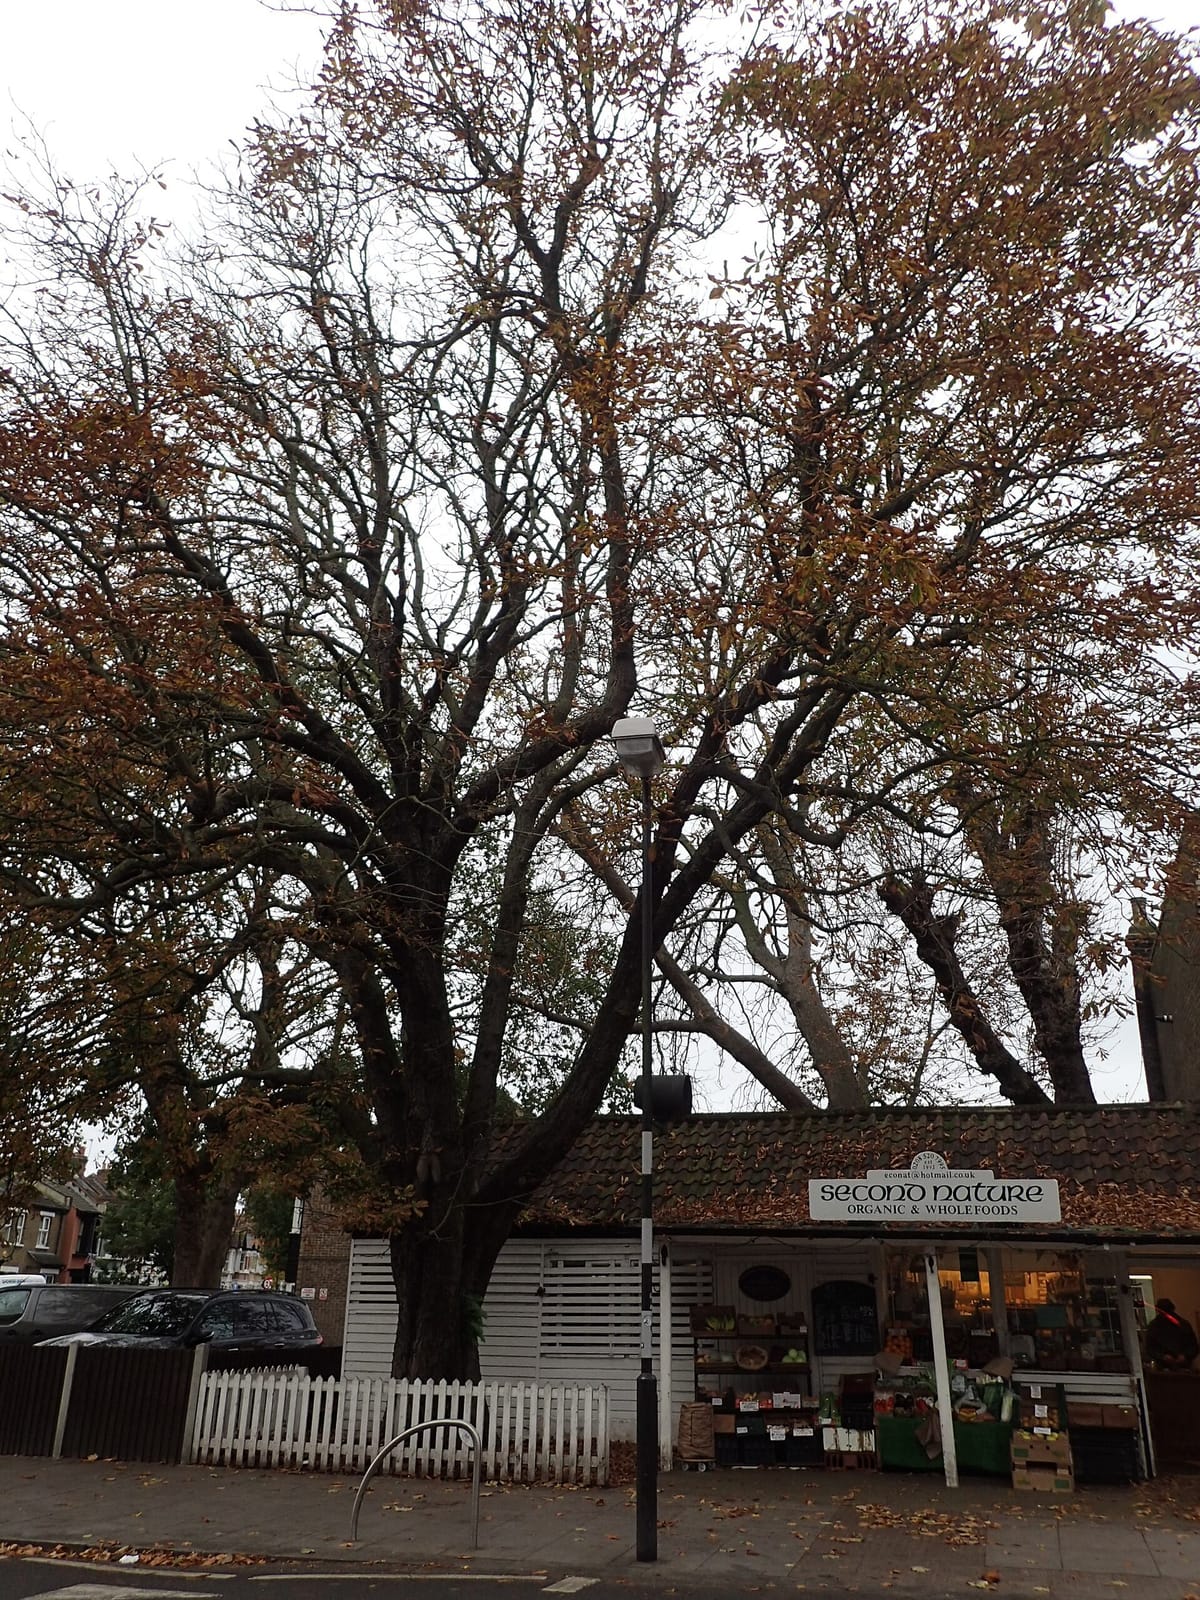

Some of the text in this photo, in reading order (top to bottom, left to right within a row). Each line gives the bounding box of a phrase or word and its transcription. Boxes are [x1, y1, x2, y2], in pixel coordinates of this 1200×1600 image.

[847, 1204, 1018, 1215] ORGANIC & WHOLEFOODS
